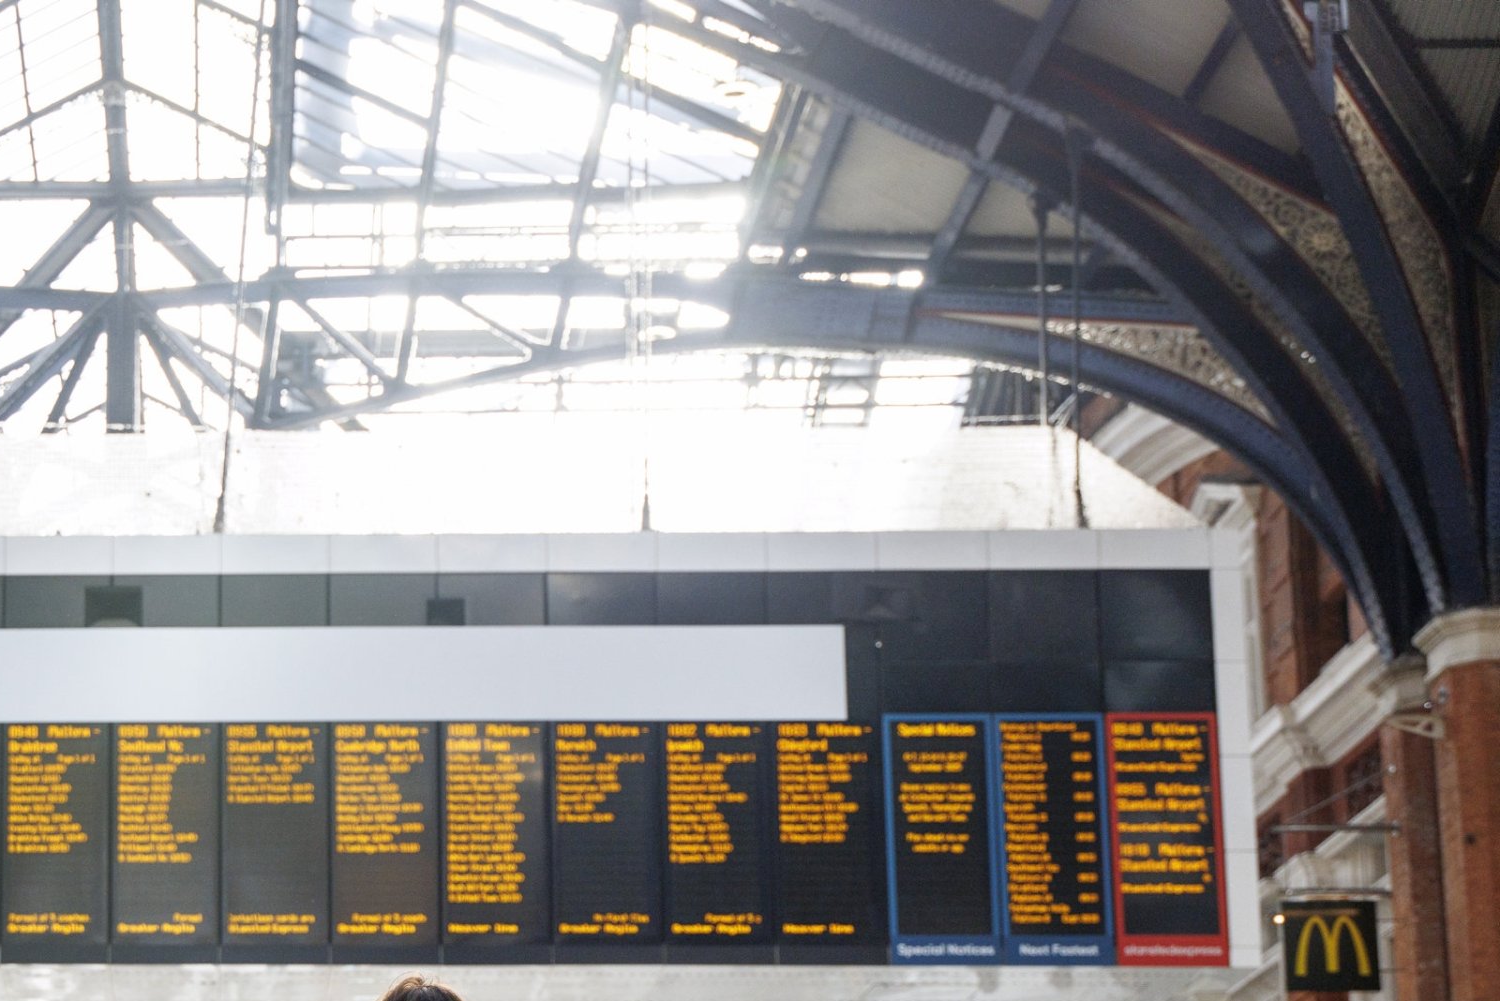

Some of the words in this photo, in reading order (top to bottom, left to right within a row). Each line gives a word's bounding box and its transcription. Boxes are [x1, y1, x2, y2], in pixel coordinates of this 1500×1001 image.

[47, 726, 91, 738] Platform
[157, 725, 202, 738] Platform
[266, 725, 310, 738] Platform
[897, 722, 935, 737] Special
[935, 723, 976, 737] Notices
[227, 739, 274, 752] Stansted
[276, 739, 313, 752] Airport
[898, 943, 945, 957] Special
[947, 943, 995, 956] Notices
[1019, 943, 1050, 956] Next
[1052, 943, 1099, 956] Fastest
